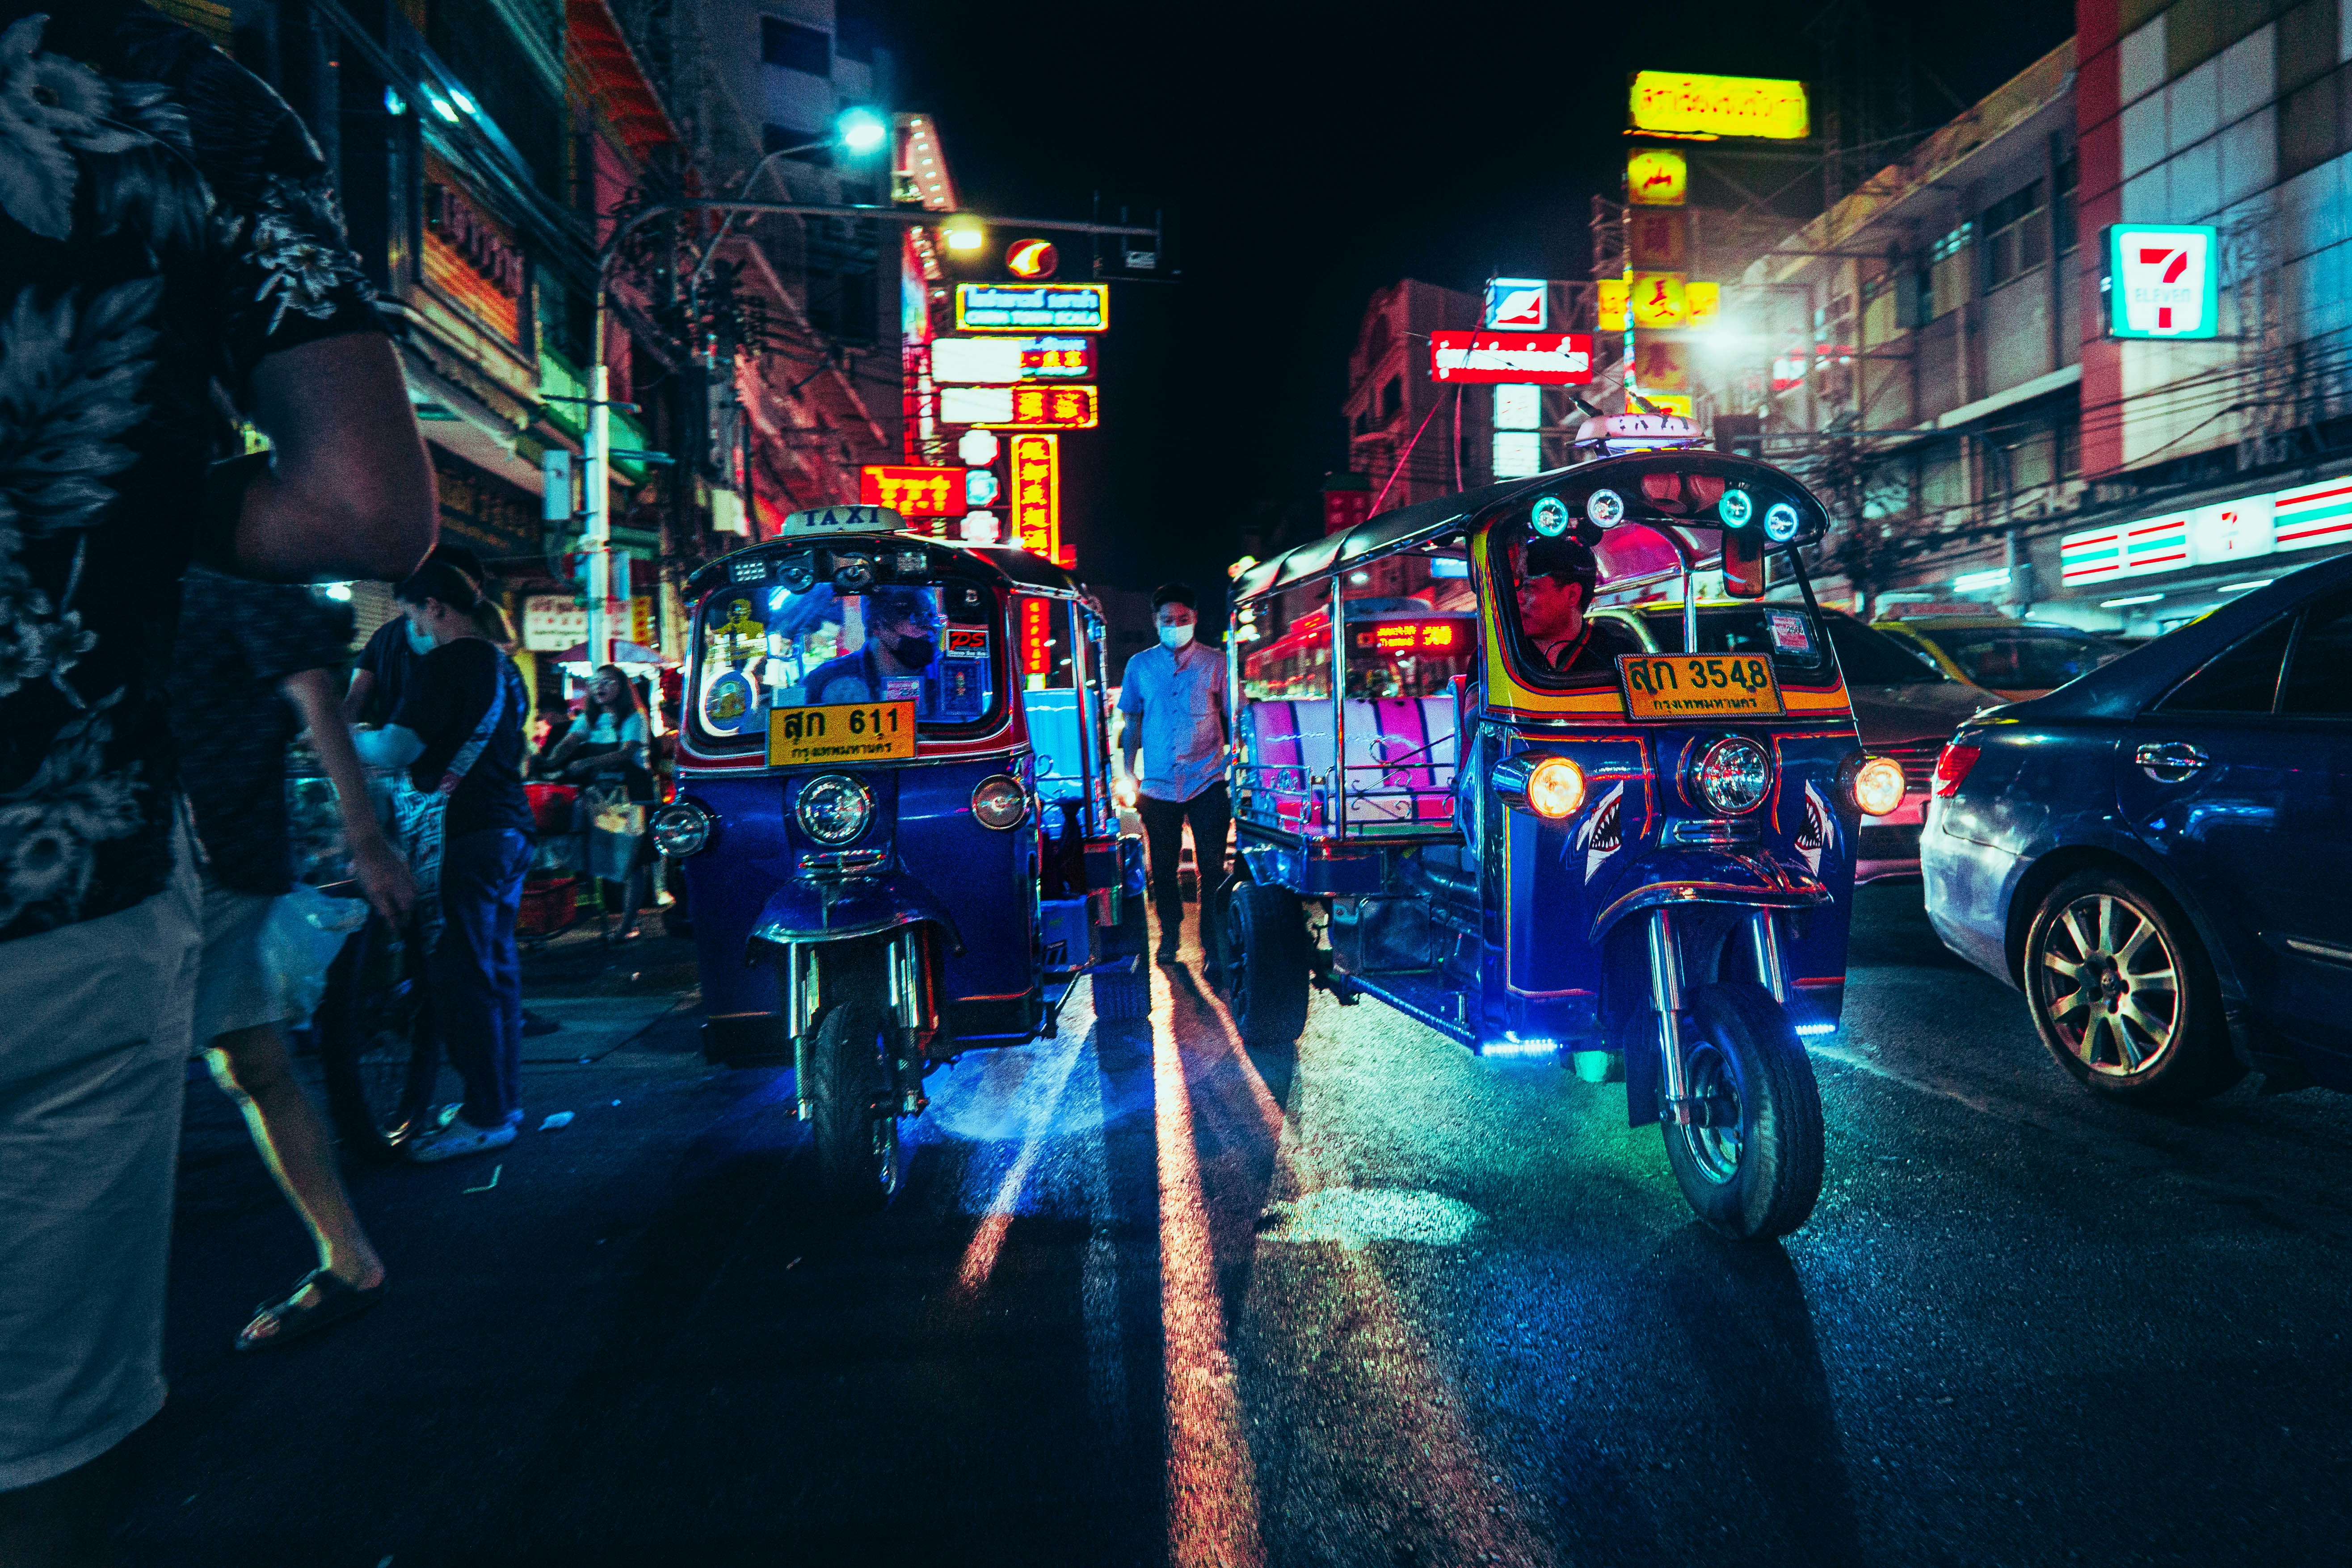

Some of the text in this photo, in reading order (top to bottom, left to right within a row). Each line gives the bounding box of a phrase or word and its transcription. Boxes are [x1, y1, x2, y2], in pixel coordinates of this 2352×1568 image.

[803, 507, 878, 526] TAXI
[949, 631, 986, 651] PS
[1688, 660, 1767, 689] 3548
[850, 708, 898, 735] 611
